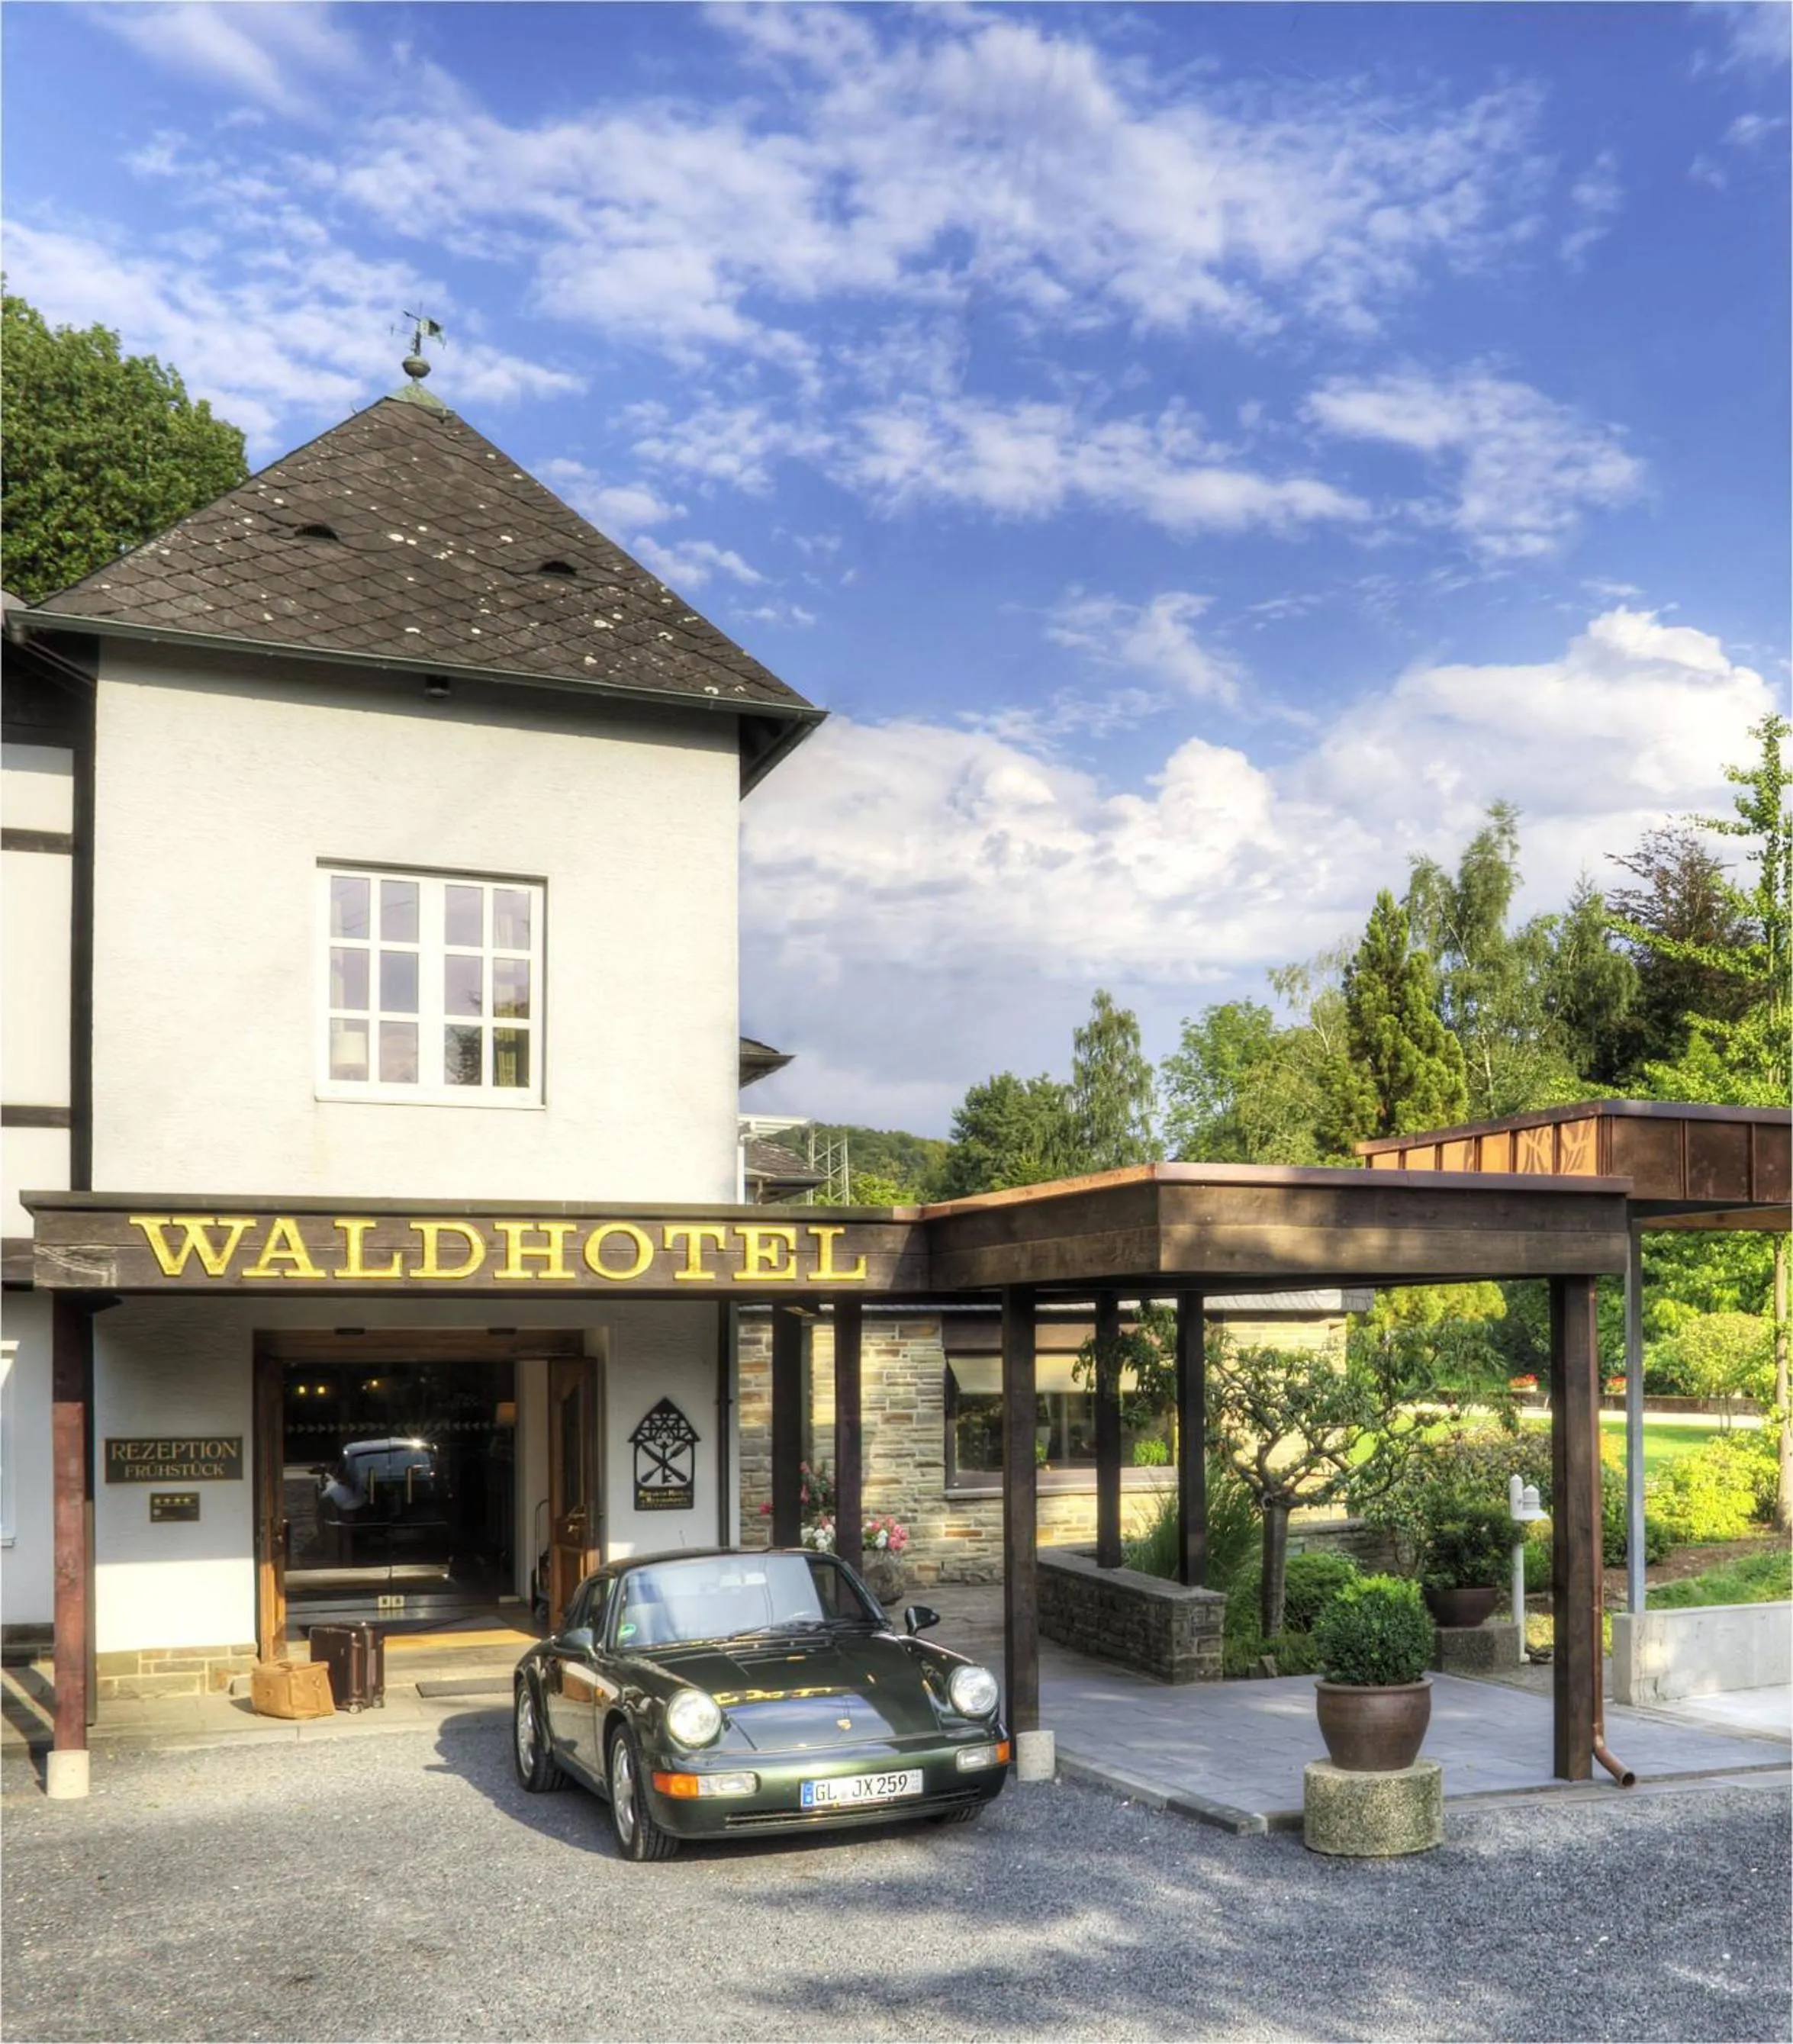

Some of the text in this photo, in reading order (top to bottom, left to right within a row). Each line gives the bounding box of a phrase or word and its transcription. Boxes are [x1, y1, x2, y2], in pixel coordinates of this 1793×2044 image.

[130, 1216, 866, 1281] WALDHOTEL
[111, 1440, 238, 1460] REZEPTION
[125, 1461, 224, 1478] FRÜHSTÜCK
[816, 1783, 837, 1801] GL
